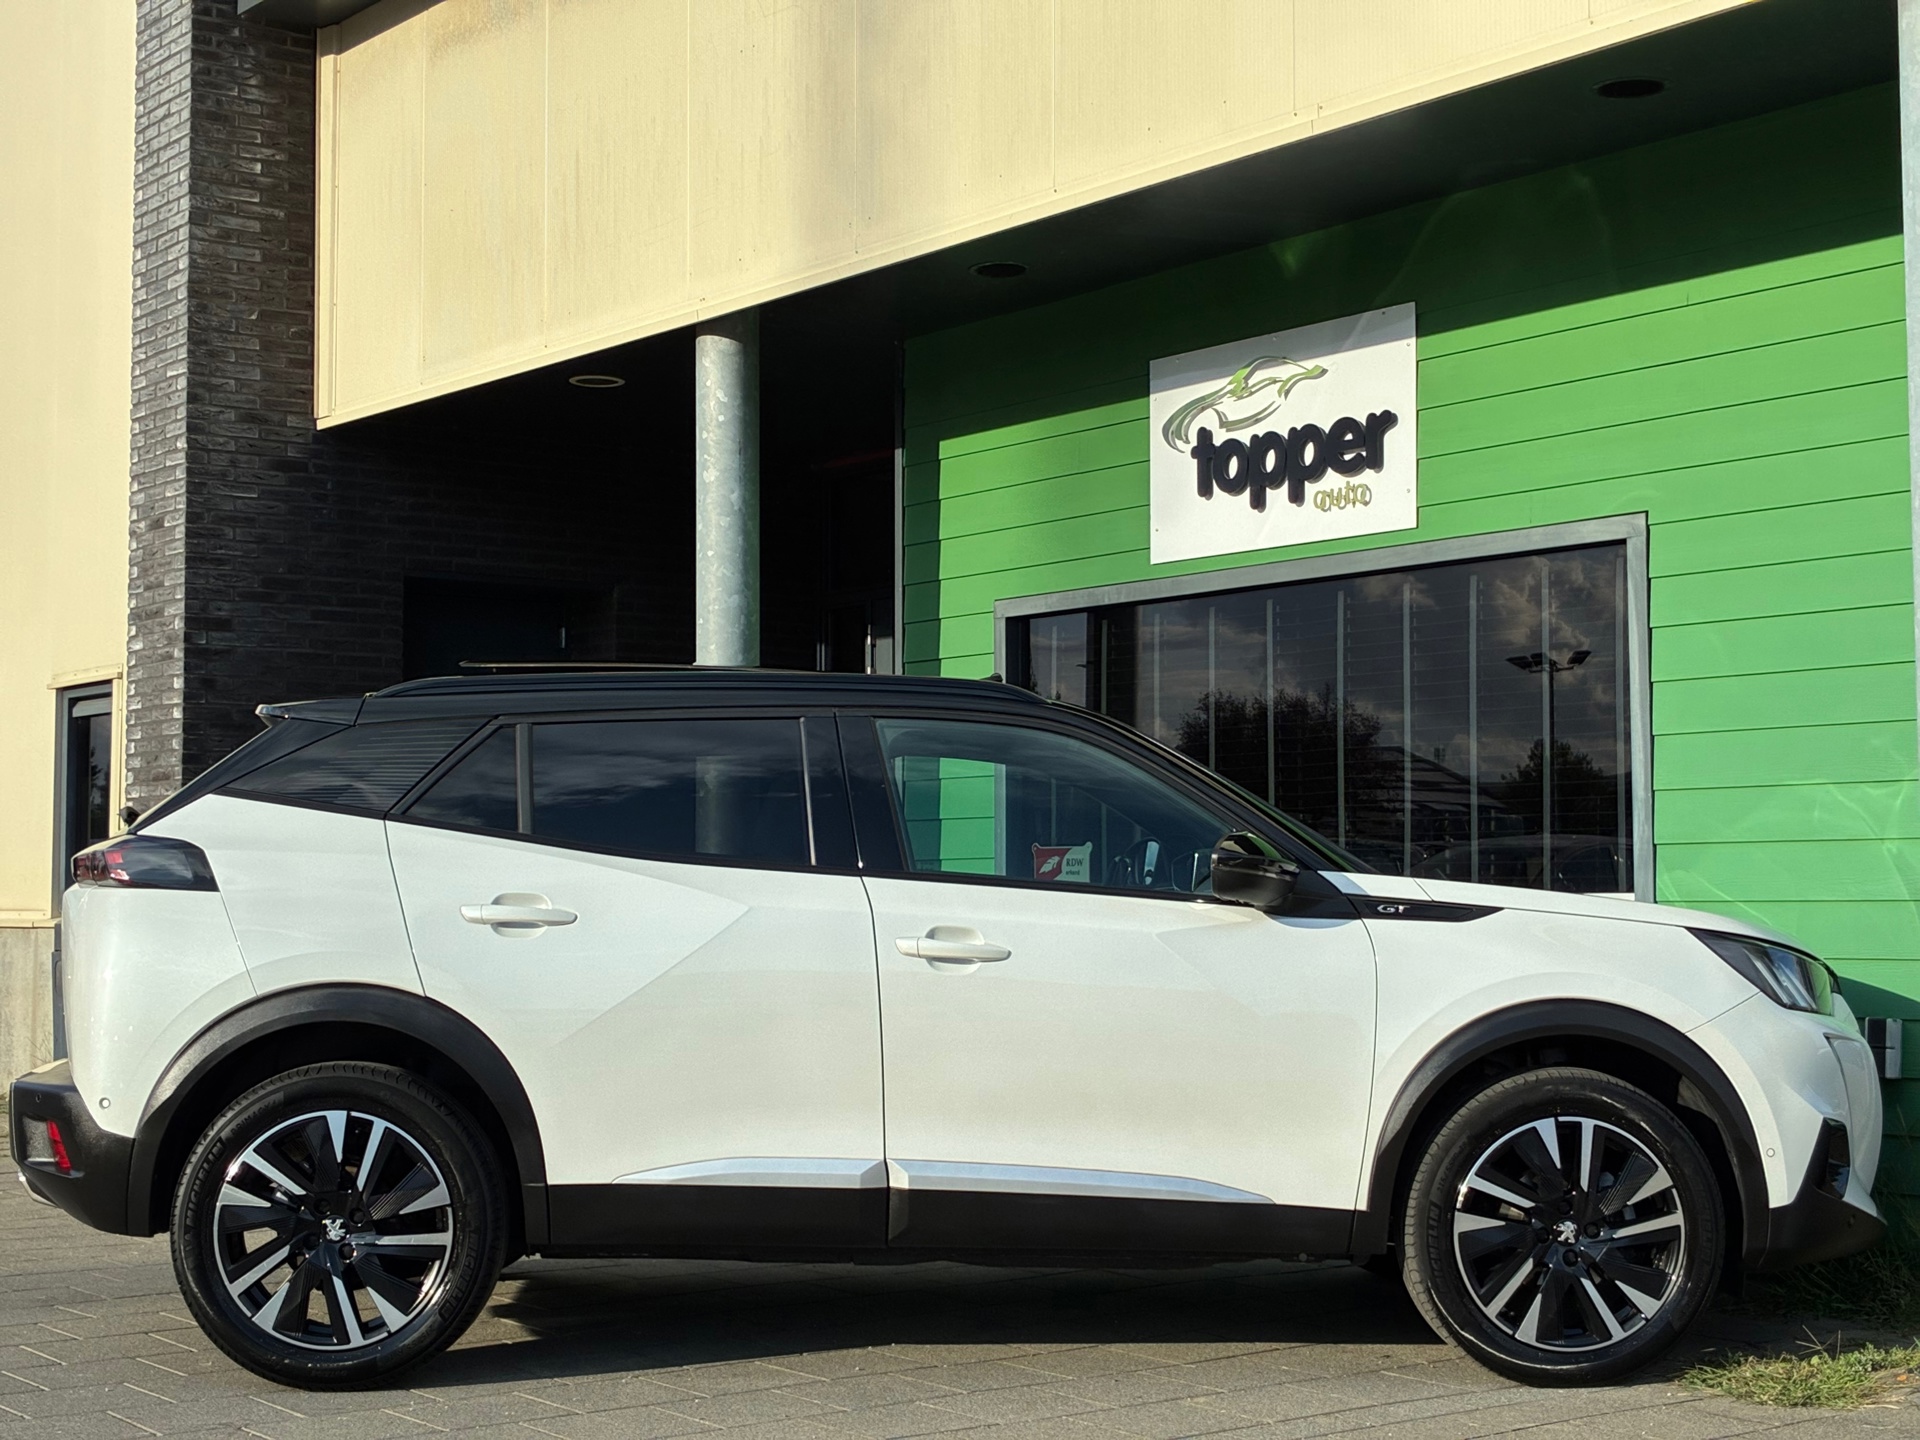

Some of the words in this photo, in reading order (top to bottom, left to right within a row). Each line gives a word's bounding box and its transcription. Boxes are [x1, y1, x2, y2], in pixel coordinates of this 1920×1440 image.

[1191, 410, 1397, 511] topper
[1313, 481, 1371, 511] auto
[1066, 858, 1084, 867] RDW
[1377, 904, 1410, 914] GT
[186, 1140, 224, 1228] MICHELIN
[438, 1231, 479, 1320] MICHELIN
[1428, 1203, 1451, 1293] MICHELIN
